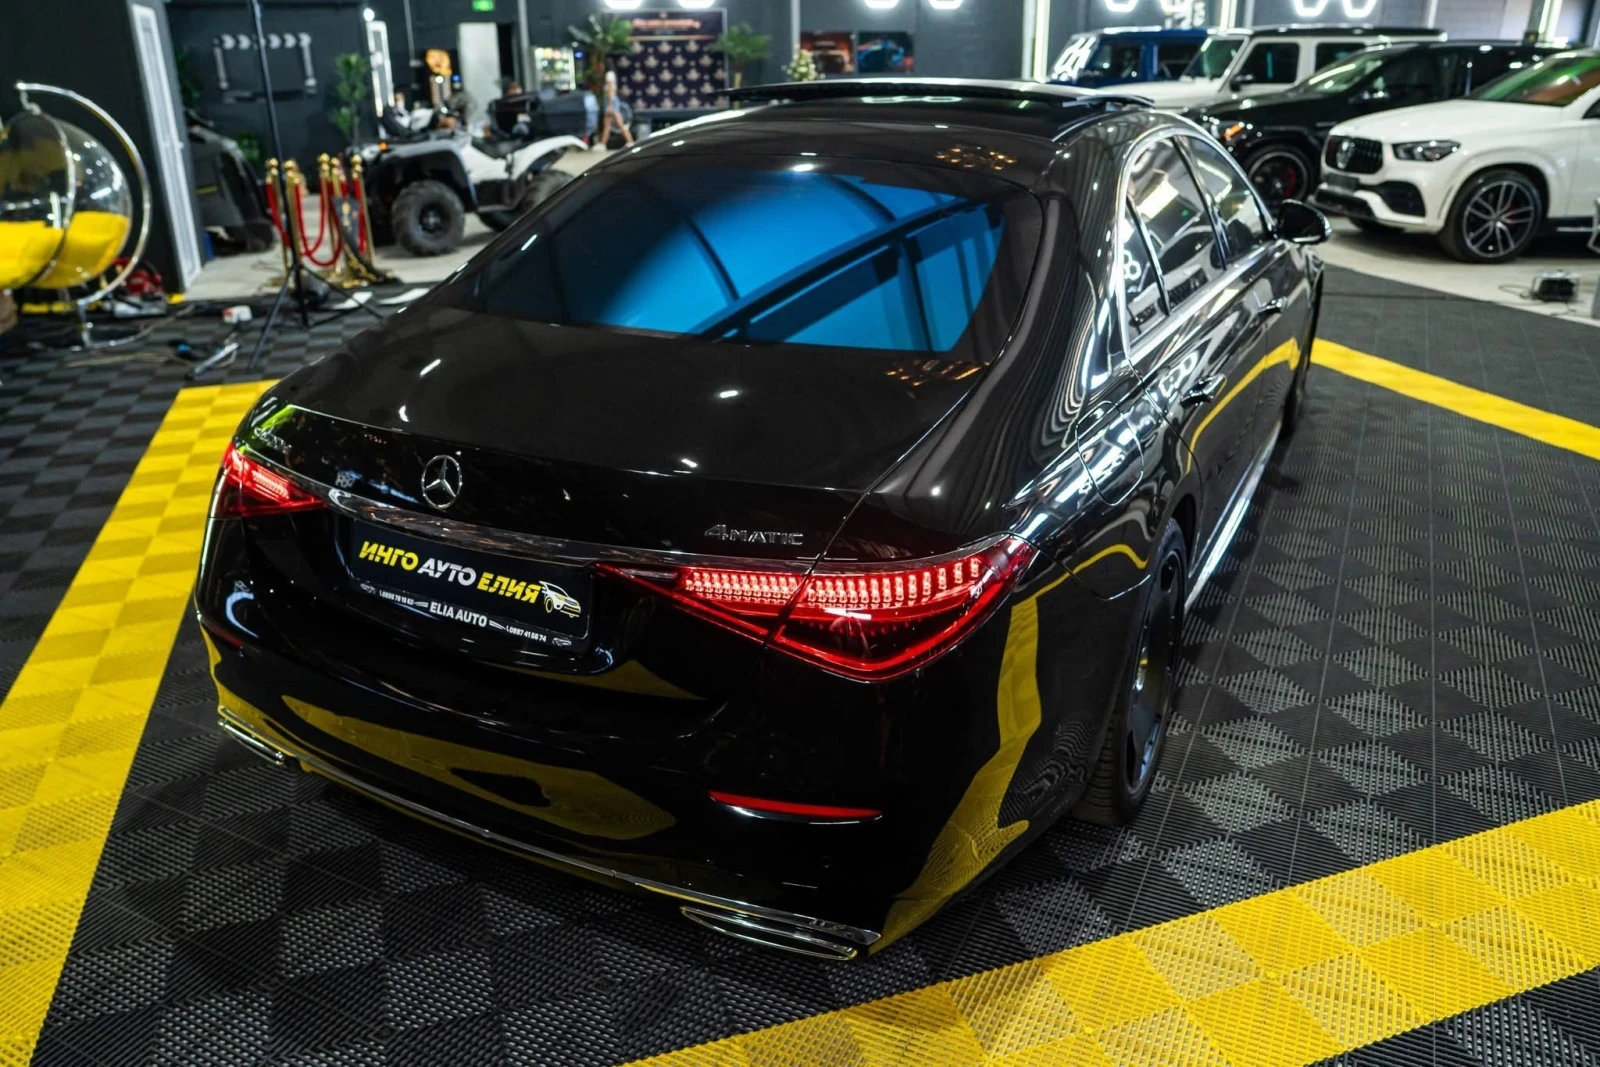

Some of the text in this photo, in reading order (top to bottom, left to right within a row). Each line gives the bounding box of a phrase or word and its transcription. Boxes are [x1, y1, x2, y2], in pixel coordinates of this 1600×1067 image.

[704, 524, 803, 545] 4MATIC
[358, 540, 541, 604] ИНГО АУТО ЕЛИЯ
[429, 601, 487, 627] ELIA AUTO
